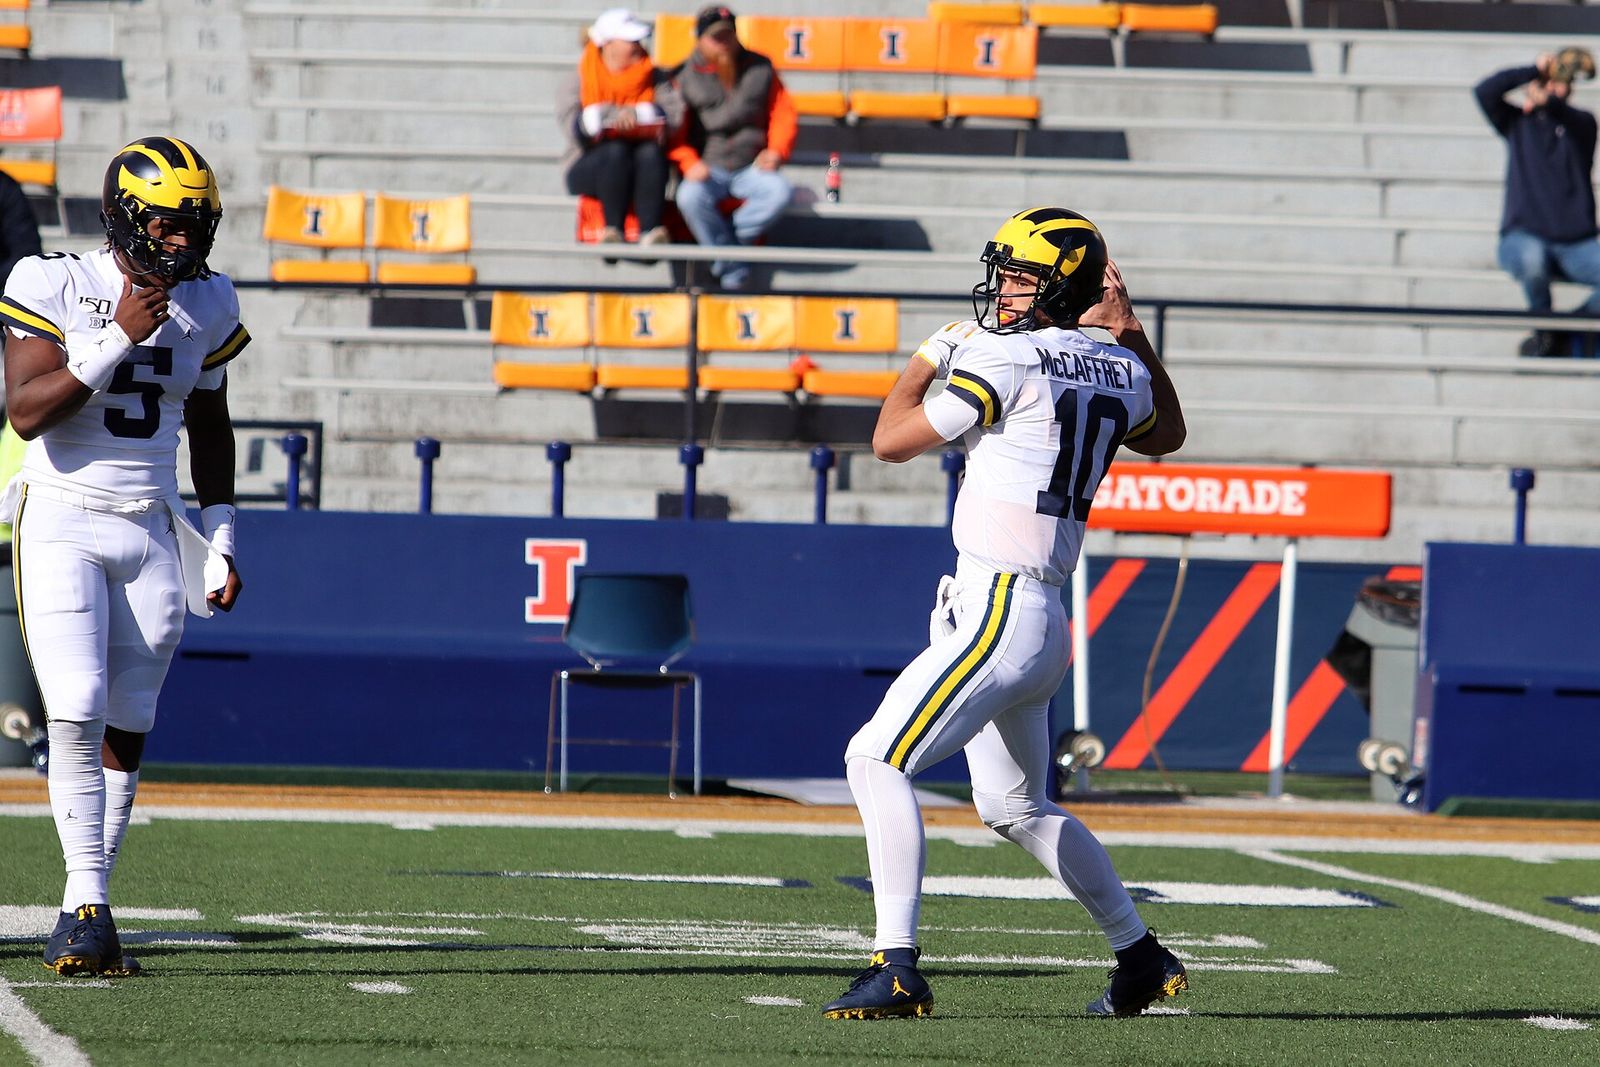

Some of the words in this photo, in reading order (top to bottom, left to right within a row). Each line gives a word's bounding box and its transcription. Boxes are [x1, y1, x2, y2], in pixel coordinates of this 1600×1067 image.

[789, 30, 808, 59] I
[884, 31, 902, 59] I
[979, 37, 997, 66] I
[305, 205, 323, 235] I
[412, 212, 430, 242] I
[530, 309, 551, 337] I
[633, 310, 654, 338] I
[738, 311, 758, 340] I
[836, 309, 858, 340] I
[1035, 347, 1133, 390] McCAFFREY
[104, 345, 173, 439] 5
[1036, 388, 1129, 523] 10
[1092, 474, 1307, 516] GATORADE
[525, 538, 587, 623] I
[870, 951, 885, 966] M
